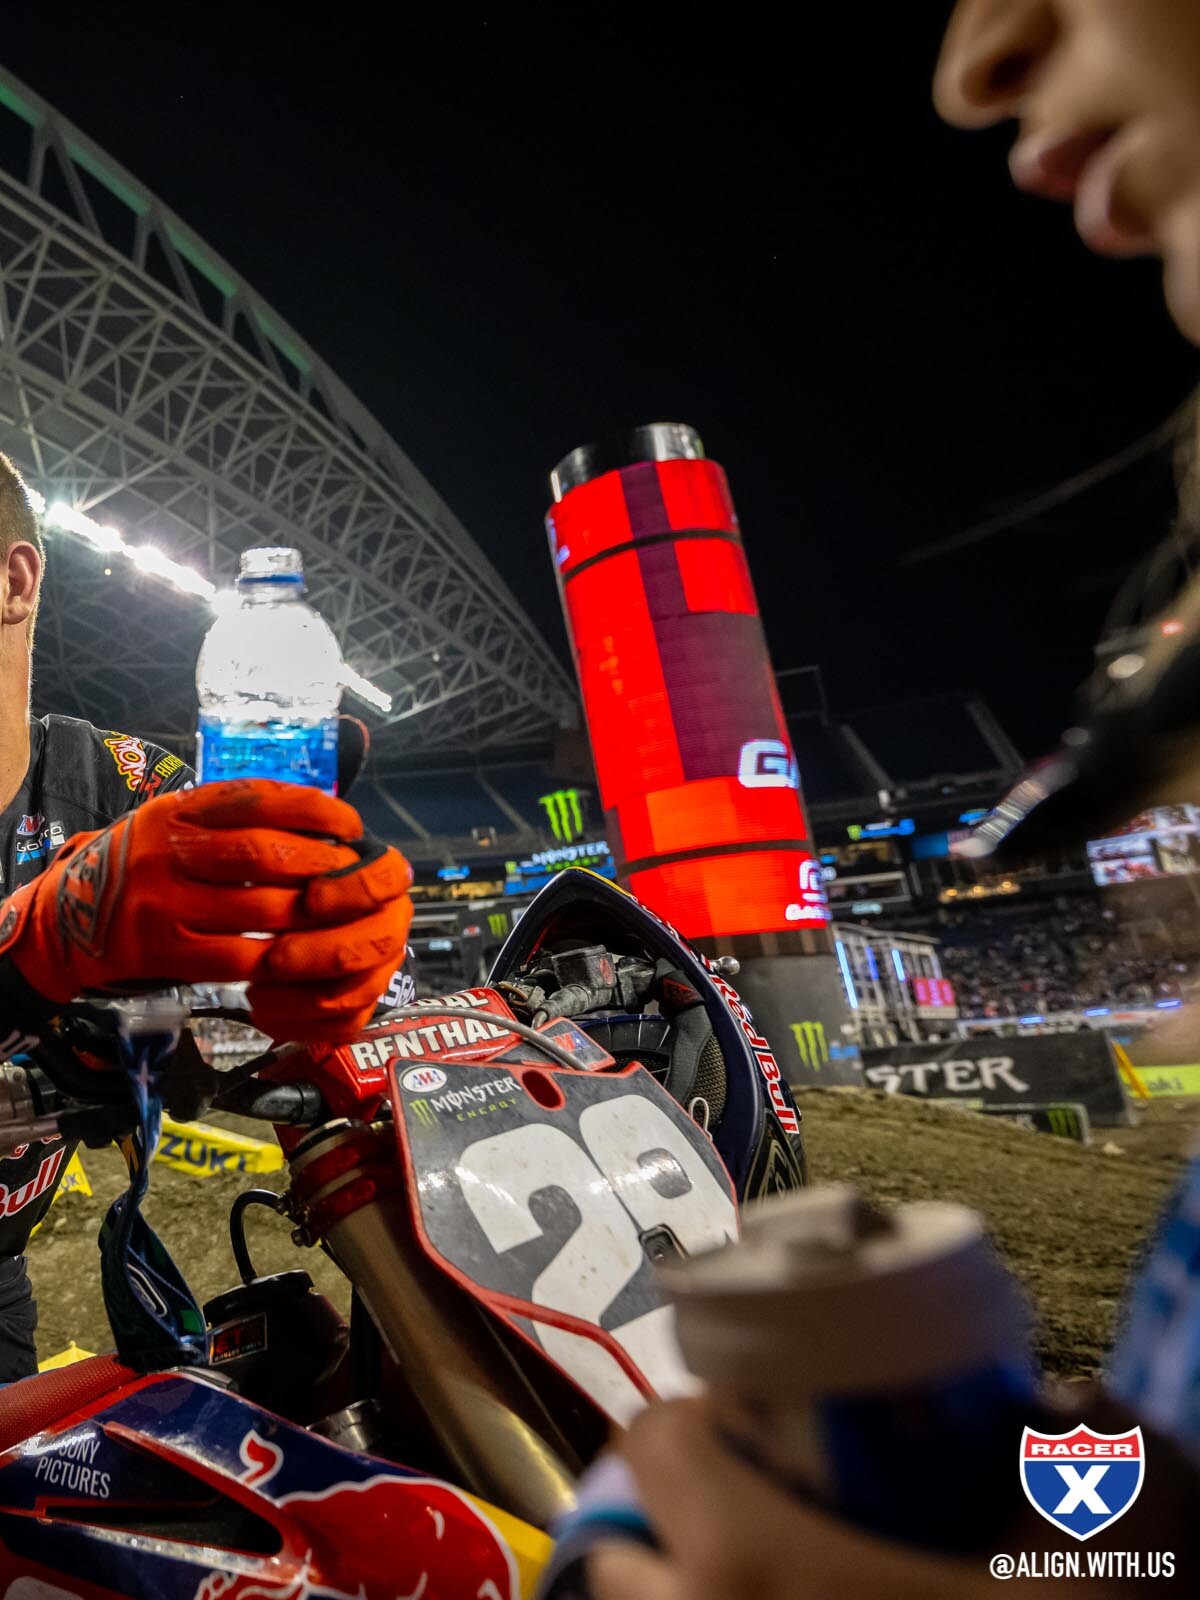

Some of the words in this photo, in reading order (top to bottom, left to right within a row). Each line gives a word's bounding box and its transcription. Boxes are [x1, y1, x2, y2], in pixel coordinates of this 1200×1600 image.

[350, 1017, 511, 1071] RENTHAL
[710, 974, 772, 1053] Red
[754, 1050, 800, 1134] Bull
[411, 1068, 443, 1089] AMA
[430, 1076, 523, 1114] MONSTER
[456, 1096, 518, 1122] ENERGY
[58, 1438, 101, 1467] SONY
[34, 1455, 112, 1499] PICTURES
